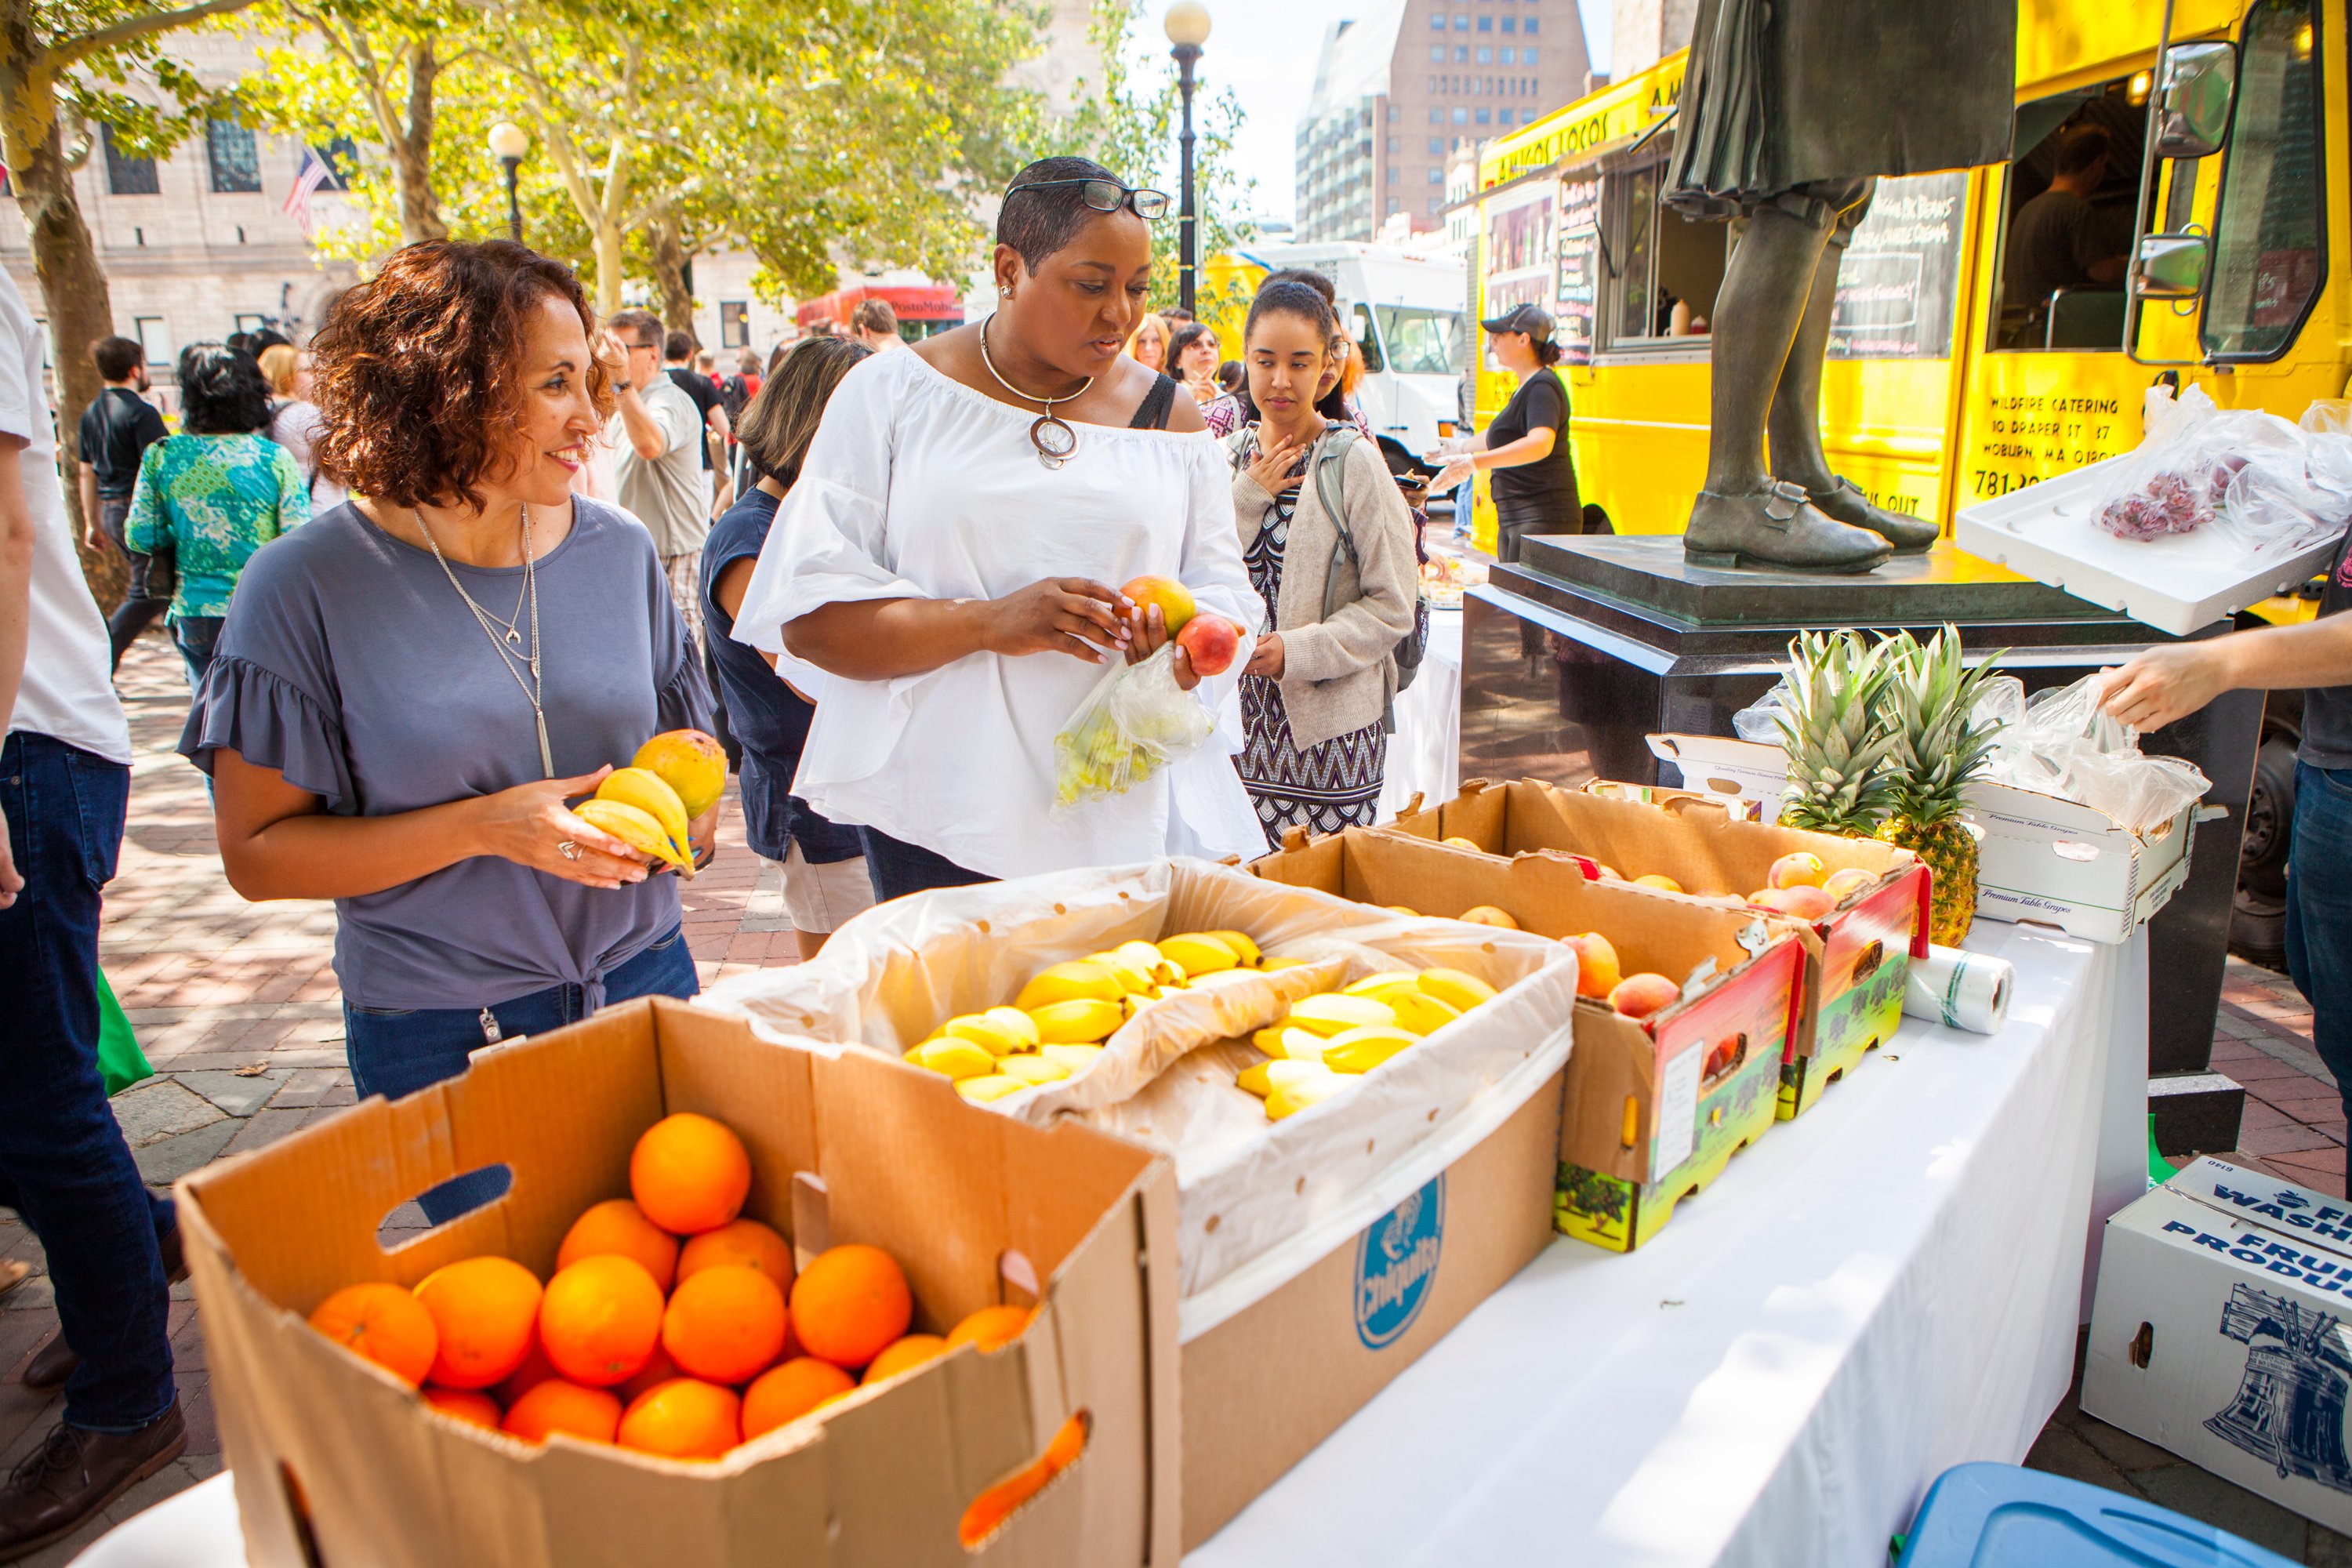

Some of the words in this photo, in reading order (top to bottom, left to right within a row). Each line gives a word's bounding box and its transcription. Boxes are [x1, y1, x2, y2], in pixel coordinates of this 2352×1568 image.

[1559, 111, 1608, 157] LOCOS
[1991, 397, 2045, 411] WILDFIRE
[2052, 398, 2118, 414] CATERING
[1993, 420, 2004, 434] 10
[2011, 420, 2060, 437] DRAPER
[2068, 424, 2082, 438] ST
[2045, 449, 2065, 463] MA
[2074, 449, 2116, 464] 0180
[1888, 495, 1919, 516] OUT
[1988, 813, 2026, 825] Premium
[2026, 819, 2049, 829] Table
[2049, 824, 2078, 836] Grapes
[1982, 888, 2019, 904] Premium
[2018, 897, 2043, 909] Table
[2043, 902, 2071, 915] Grapes
[2208, 1160, 2234, 1173] 6140
[2213, 1183, 2352, 1245] WASH
[1360, 1235, 1439, 1324] Chiquita
